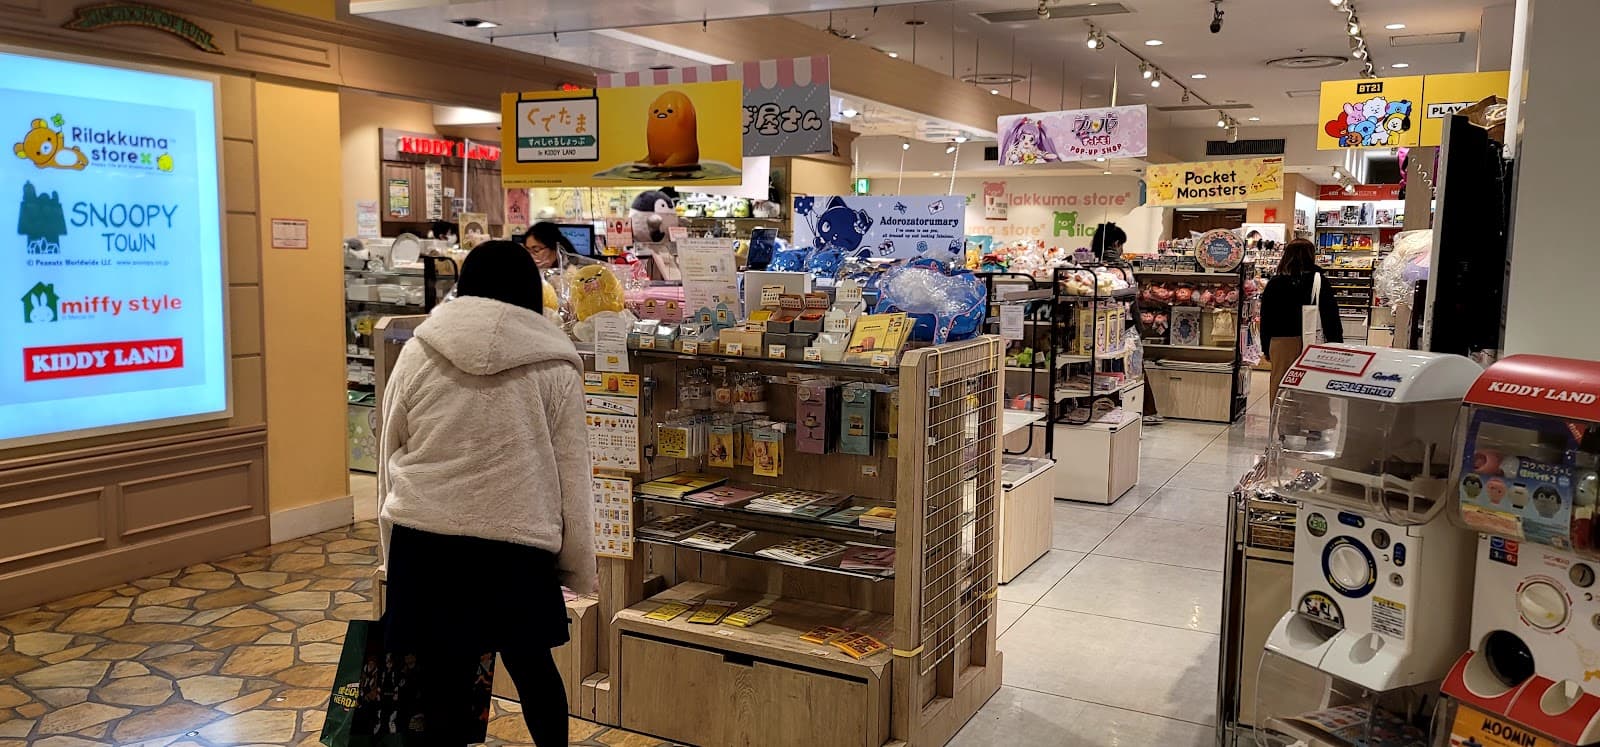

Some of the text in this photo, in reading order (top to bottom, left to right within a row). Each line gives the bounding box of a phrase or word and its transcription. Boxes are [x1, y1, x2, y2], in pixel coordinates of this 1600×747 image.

[1358, 84, 1381, 93] BT21
[71, 126, 169, 149] Rilakkuma
[400, 135, 454, 158] KIDDY
[91, 147, 139, 164] store
[1070, 143, 1122, 156] POP-UP SHOP
[1185, 170, 1237, 185] Pocket
[1177, 184, 1247, 199] Monsters
[70, 201, 178, 229] SNOOPY
[879, 216, 959, 228] Adorozatorumary
[101, 232, 156, 252] TOWN
[61, 294, 182, 316] miffy style
[31, 345, 175, 373] KIDDY LAND
[1327, 380, 1395, 397] CAPSULE STATION
[1488, 381, 1597, 405] KIDDY LAND
[1481, 717, 1537, 747] MOOMIN
